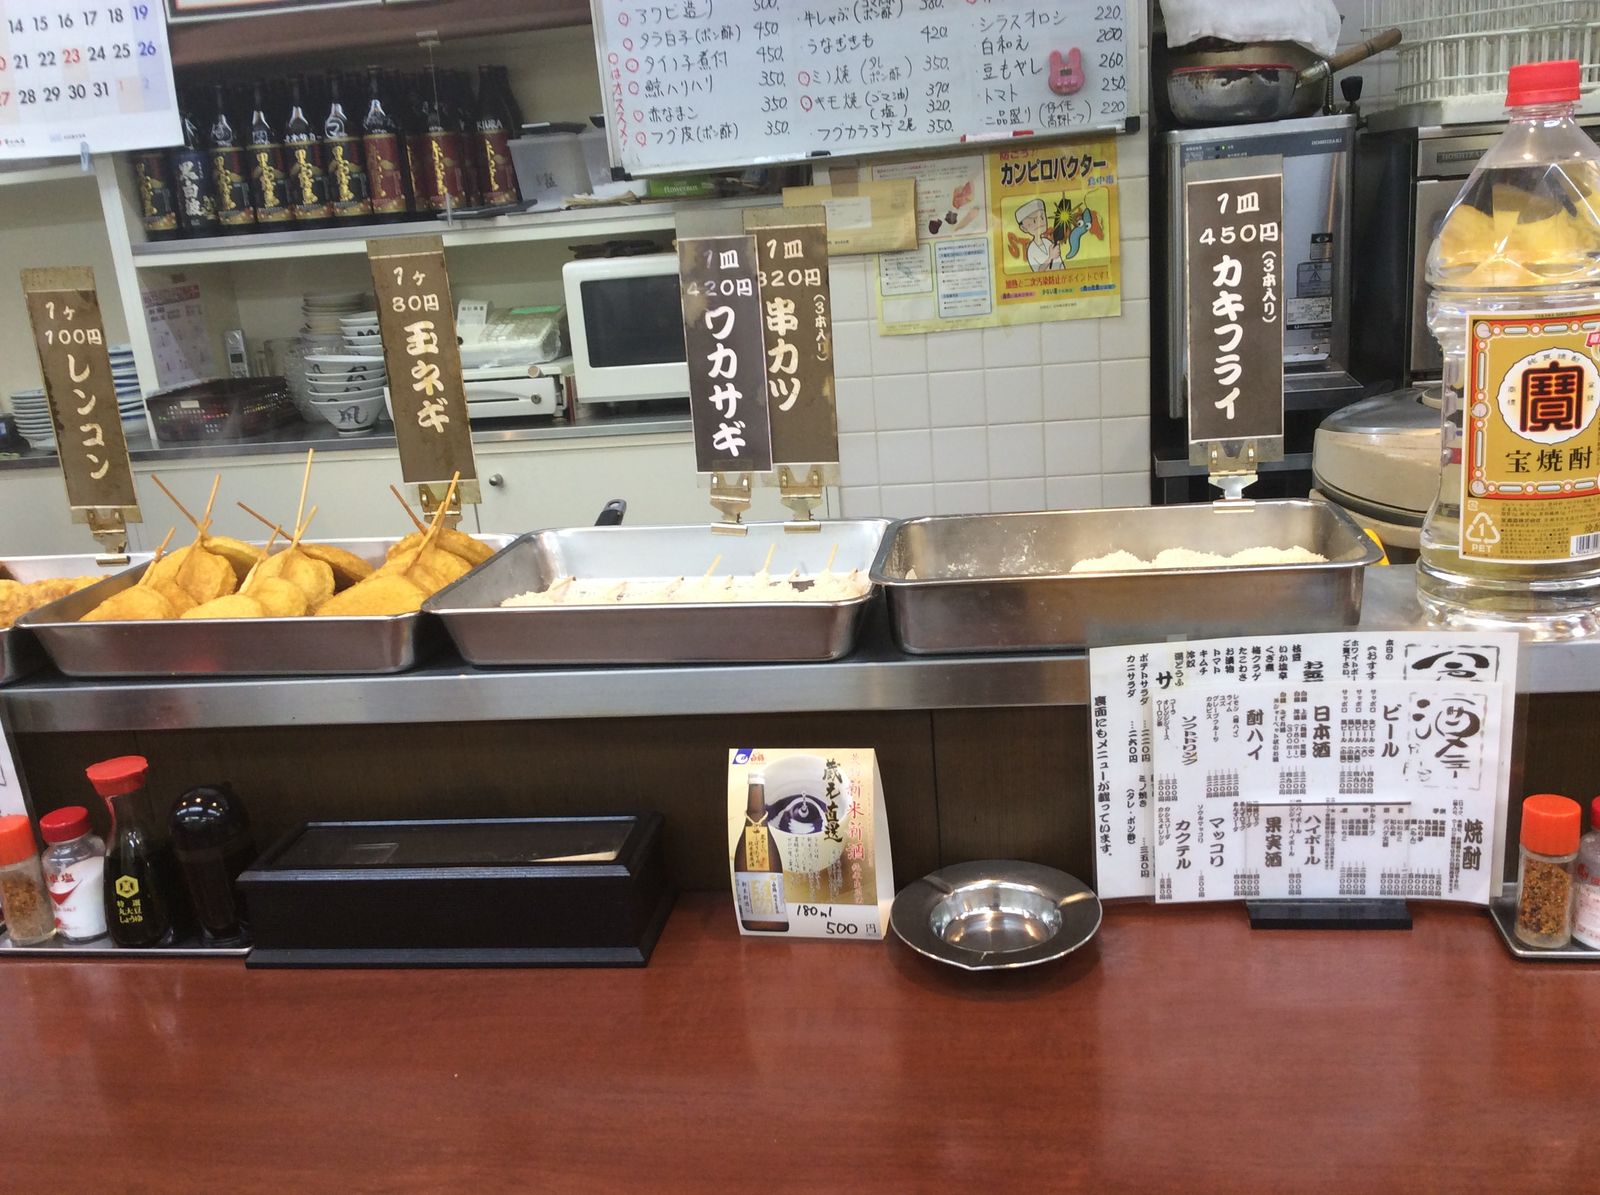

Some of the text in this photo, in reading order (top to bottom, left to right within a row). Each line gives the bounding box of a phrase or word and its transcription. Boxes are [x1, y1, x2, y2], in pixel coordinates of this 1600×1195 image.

[9, 5, 148, 34] 14 15 16 17 18 19
[13, 41, 157, 69] 21 22 23 24 25 26
[18, 90, 36, 104] 28
[43, 87, 60, 102] 29
[68, 84, 86, 99] 30
[93, 82, 109, 97] 31
[984, 84, 1019, 103] トマト
[1001, 154, 1106, 186] カンピロバクター
[1199, 222, 1279, 245] 450円
[45, 328, 103, 345] 100円
[766, 297, 801, 412] 串カツ
[1212, 254, 1245, 420] カキフライ
[403, 320, 450, 433] 玉ネギ
[704, 305, 747, 457] ワカサギ
[66, 353, 110, 480] レンコン
[1505, 446, 1593, 473] 宝焼酎
[1472, 543, 1494, 552] PET
[1127, 655, 1137, 698] カニサラダ
[1140, 653, 1150, 705] ポテトサラダ
[1200, 650, 1208, 675] キムチ
[1213, 649, 1221, 674] トマト
[1239, 647, 1247, 681] たこわさ
[1247, 709, 1264, 760] 酎ハイ
[1312, 706, 1331, 758] 日本酒
[1381, 704, 1402, 758] ビール
[1175, 820, 1192, 870] カクテル
[1209, 817, 1224, 867] マッコリ
[1265, 816, 1282, 868] 果実酒
[1304, 815, 1321, 866] ハイボール
[1462, 819, 1482, 871] 焼酎
